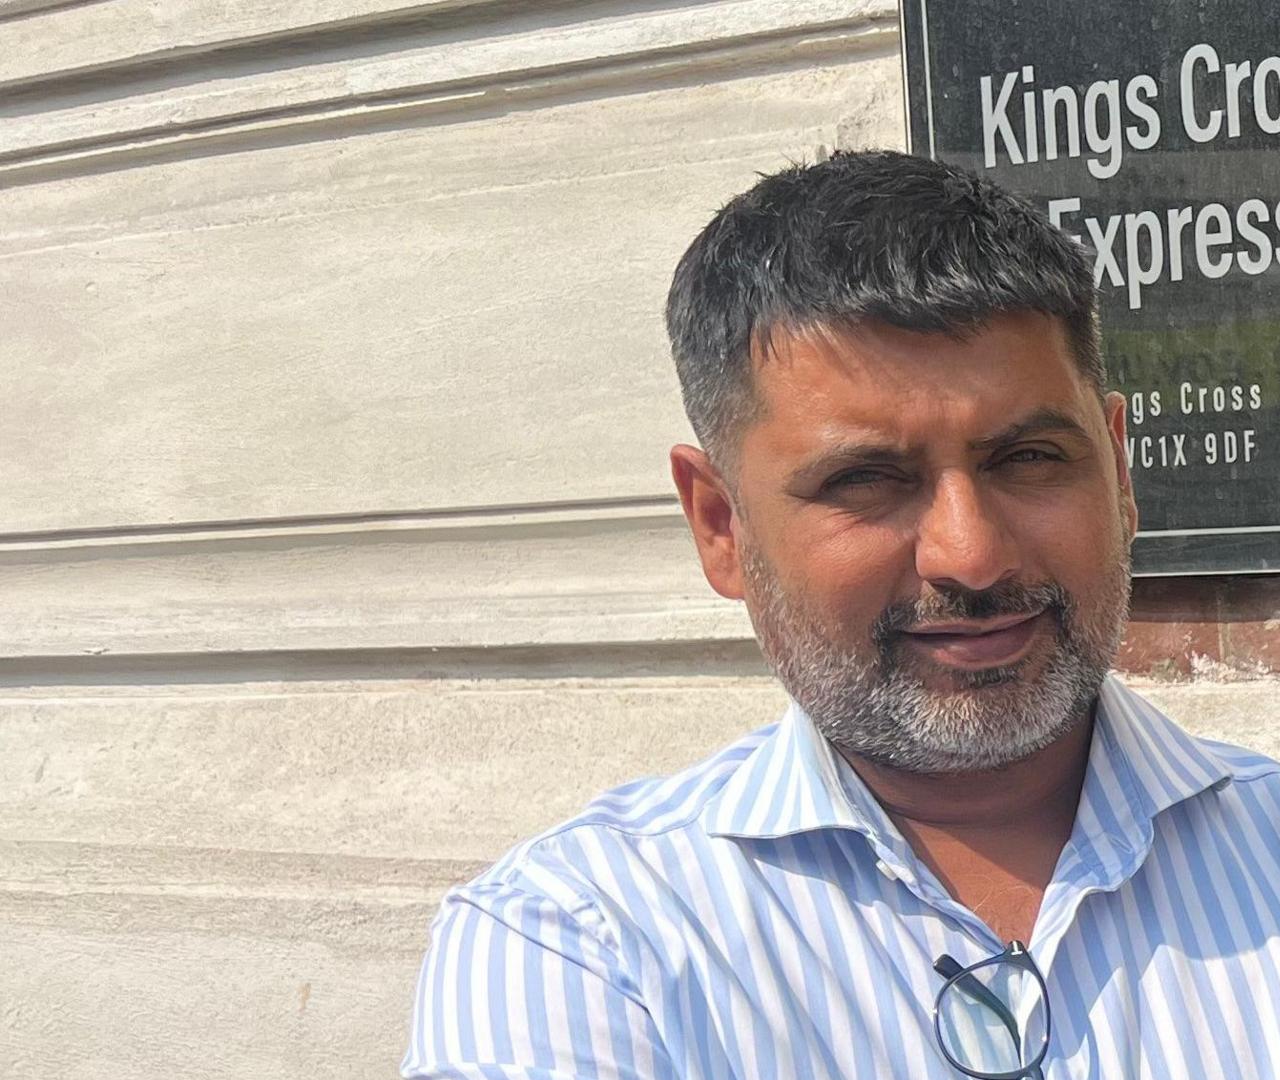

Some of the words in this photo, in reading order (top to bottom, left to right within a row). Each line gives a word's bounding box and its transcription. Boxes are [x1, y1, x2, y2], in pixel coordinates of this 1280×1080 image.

[980, 65, 1161, 179] Kings
[1180, 382, 1262, 415] Cross
[1204, 430, 1256, 465] 9DF
